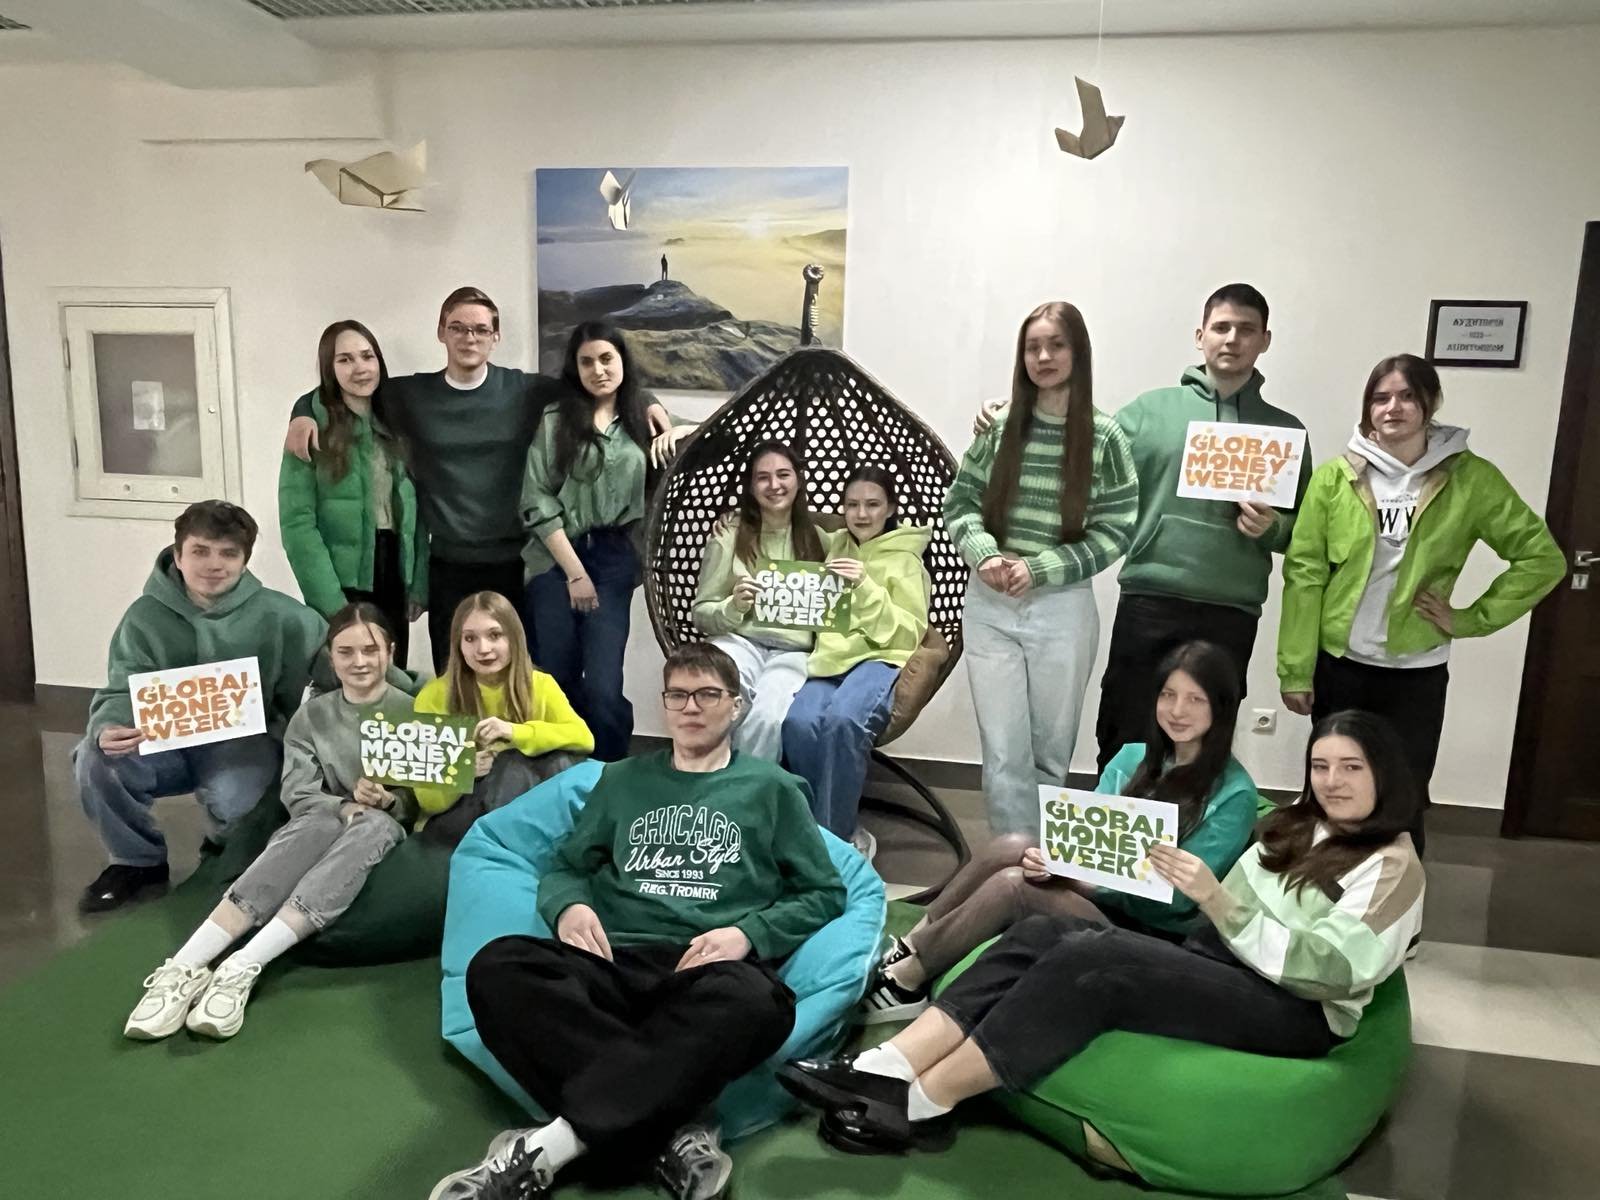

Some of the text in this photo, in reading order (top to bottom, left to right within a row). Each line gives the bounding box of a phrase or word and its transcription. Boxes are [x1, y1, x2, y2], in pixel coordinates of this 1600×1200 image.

[1187, 453, 1287, 475] MONEY
[1185, 469, 1265, 492] WEEK
[755, 588, 842, 610] MONEY
[755, 605, 825, 626] WEEK
[139, 690, 247, 724] MONEY
[141, 711, 232, 741] WEEK
[361, 740, 464, 765] MONEY
[361, 758, 445, 784] WEEK
[629, 804, 741, 851] CHICAGO
[1046, 820, 1160, 859] MONEY
[625, 838, 740, 874] Urban Style
[1046, 839, 1138, 880] WEEK
[681, 869, 704, 880] 1993
